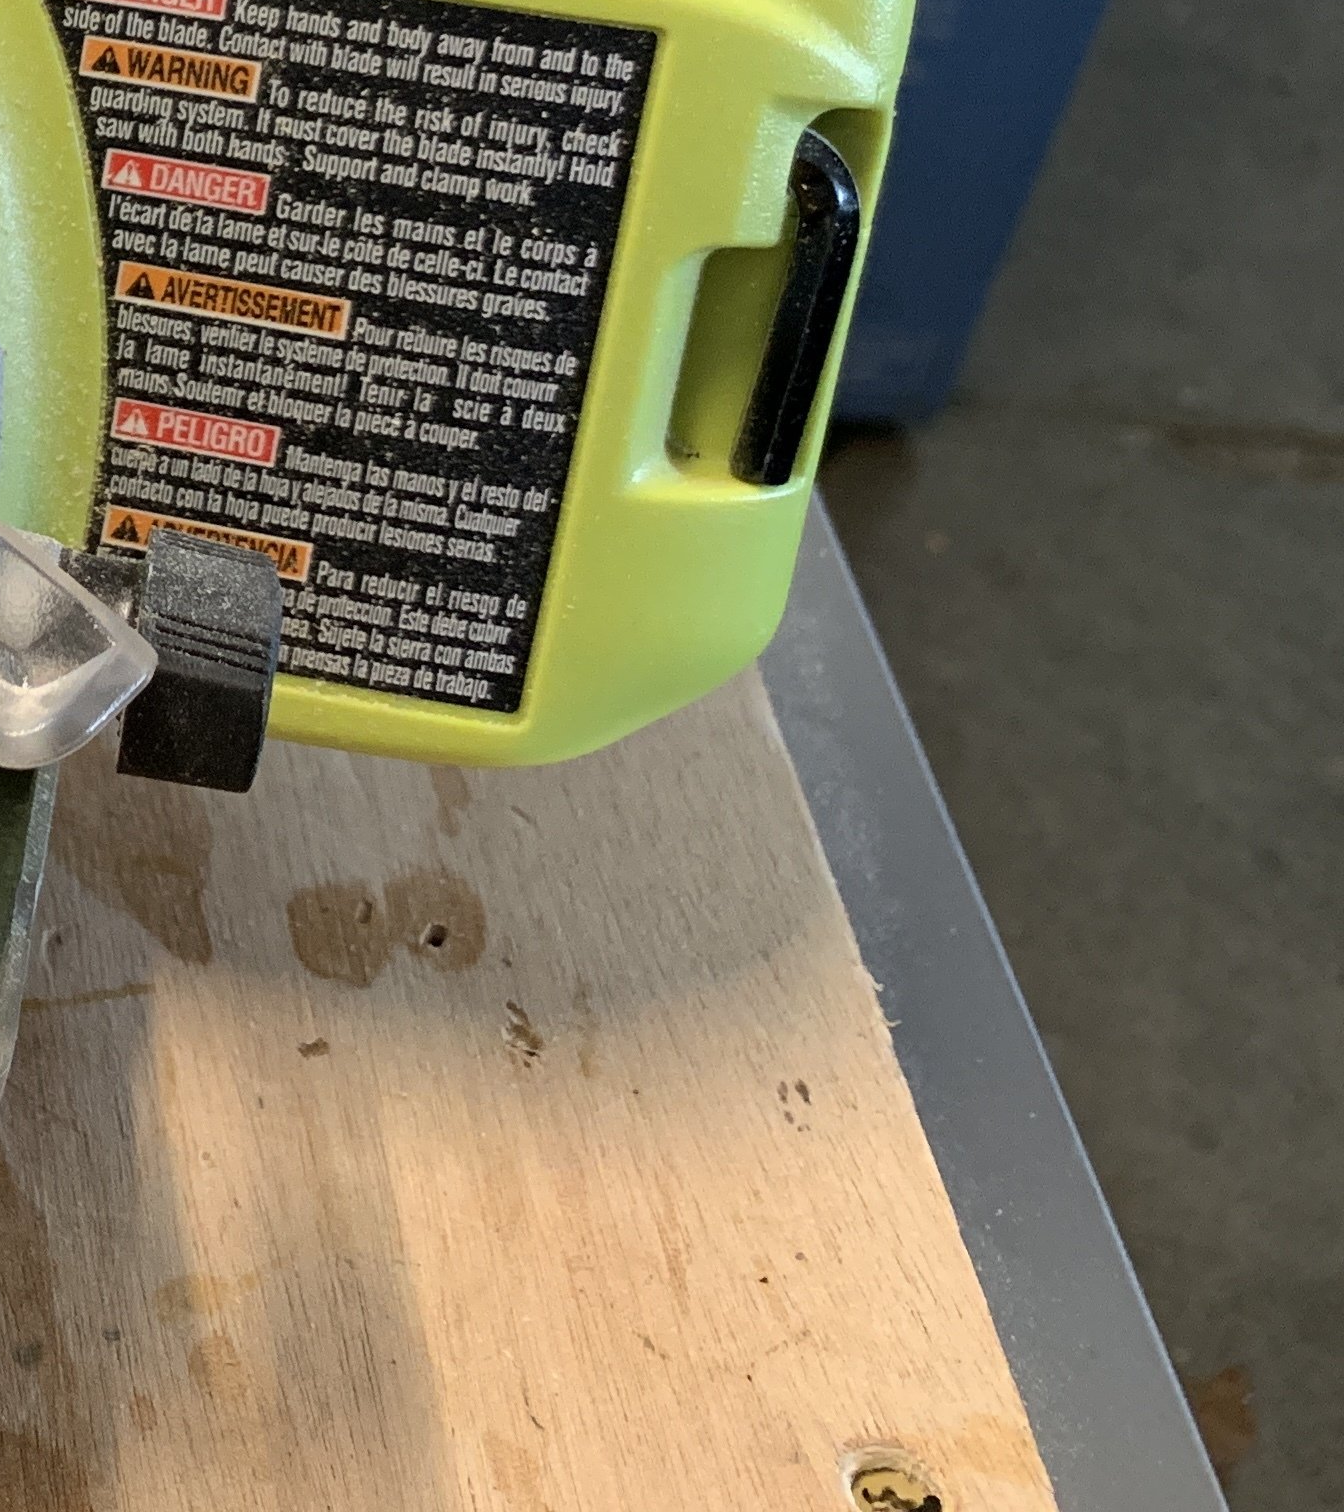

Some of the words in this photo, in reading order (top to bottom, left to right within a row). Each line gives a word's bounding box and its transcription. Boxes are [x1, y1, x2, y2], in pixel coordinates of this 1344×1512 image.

[62, 4, 99, 31] side
[103, 10, 122, 35] of
[125, 12, 151, 39] the
[157, 17, 211, 49] blade.
[217, 26, 286, 60] Contact
[288, 39, 327, 67] with
[330, 44, 382, 75] blade
[384, 55, 420, 81] will
[422, 62, 475, 90] result
[477, 66, 498, 93] in
[499, 74, 566, 104] serious
[285, 5, 341, 37] hands
[346, 18, 382, 43] and
[386, 20, 431, 56] body
[436, 32, 486, 64] away
[490, 36, 534, 67] from
[540, 47, 575, 73] and
[579, 50, 599, 77] to
[603, 54, 633, 82] the
[88, 85, 172, 122] guarding
[176, 99, 247, 130] system.
[255, 107, 270, 133] It
[273, 114, 323, 141] must
[324, 122, 379, 150] cover
[381, 127, 413, 156] the
[417, 133, 472, 165] blade
[476, 142, 565, 184] instantly!
[568, 157, 614, 188] Hold
[125, 48, 250, 93] WARNING
[266, 81, 289, 108] To
[297, 89, 366, 120] reduce
[373, 97, 407, 126] the
[414, 105, 455, 133] risk
[460, 112, 484, 137] of
[487, 115, 549, 152] injury,
[560, 128, 621, 159] check
[94, 115, 134, 141] saw
[136, 121, 178, 148] with
[181, 125, 224, 155] both
[302, 145, 377, 180] Support
[380, 161, 418, 186] and
[420, 166, 480, 202] clamp
[483, 178, 534, 206] work.
[107, 195, 167, 228] l'écart
[216, 213, 266, 244] lame
[266, 223, 288, 248] et
[288, 229, 318, 253] sur
[342, 236, 385, 264] côté
[385, 241, 411, 268] de
[413, 249, 487, 281] celle-ci.
[492, 259, 518, 286] Le
[519, 267, 591, 298] contact
[150, 164, 258, 206] DANGER
[274, 194, 346, 229] Garder
[352, 206, 385, 235] les
[391, 217, 456, 246] mains
[463, 226, 486, 251] et
[492, 229, 513, 255] le
[520, 237, 579, 269] corps
[583, 243, 599, 269] à
[111, 228, 156, 255] avec
[159, 233, 177, 259] la
[182, 236, 231, 267] lame
[233, 249, 278, 275] peut
[280, 257, 344, 286] causer
[347, 264, 383, 293] des
[386, 270, 480, 309] blessures
[481, 290, 550, 321] graves.
[163, 276, 339, 331] AVERTISSEMENT
[351, 319, 394, 348] Pour
[395, 327, 457, 358] réduire
[460, 336, 487, 363] les
[489, 341, 551, 374] risques
[553, 351, 576, 377] de
[276, 336, 343, 367] système
[367, 352, 450, 386] protection.
[455, 363, 470, 388] Il
[469, 365, 502, 394] doit
[502, 375, 558, 404] couvrir
[116, 335, 135, 361] la
[144, 339, 190, 370] lame
[357, 376, 404, 407] Tenir
[413, 386, 432, 412] la
[452, 396, 491, 422] scie
[521, 404, 566, 435] deux
[267, 389, 332, 424] bloquer
[335, 401, 352, 427] la
[418, 420, 480, 452] couper.
[158, 413, 265, 456] PELIGRO
[283, 445, 363, 485] Mantenga
[365, 459, 390, 486] las
[392, 468, 446, 496] manos
[461, 477, 478, 501] el
[480, 483, 521, 509] resto
[522, 486, 549, 513] del
[109, 473, 174, 503] contacto
[224, 490, 260, 522] hoja
[260, 501, 310, 528] puede
[311, 510, 376, 541] producir
[379, 518, 444, 553] lesiones
[315, 561, 355, 591] Para
[360, 572, 420, 602] reducir
[425, 582, 442, 605] el
[448, 585, 500, 619] riesgo
[505, 594, 527, 620] de
[398, 604, 430, 632] Este
[430, 609, 467, 638] debe
[468, 619, 510, 646] cubrir
[291, 645, 350, 674] prensas
[369, 657, 411, 685] pieza
[386, 632, 431, 661] sierra
[433, 642, 461, 666] con
[464, 647, 514, 675] ambas
